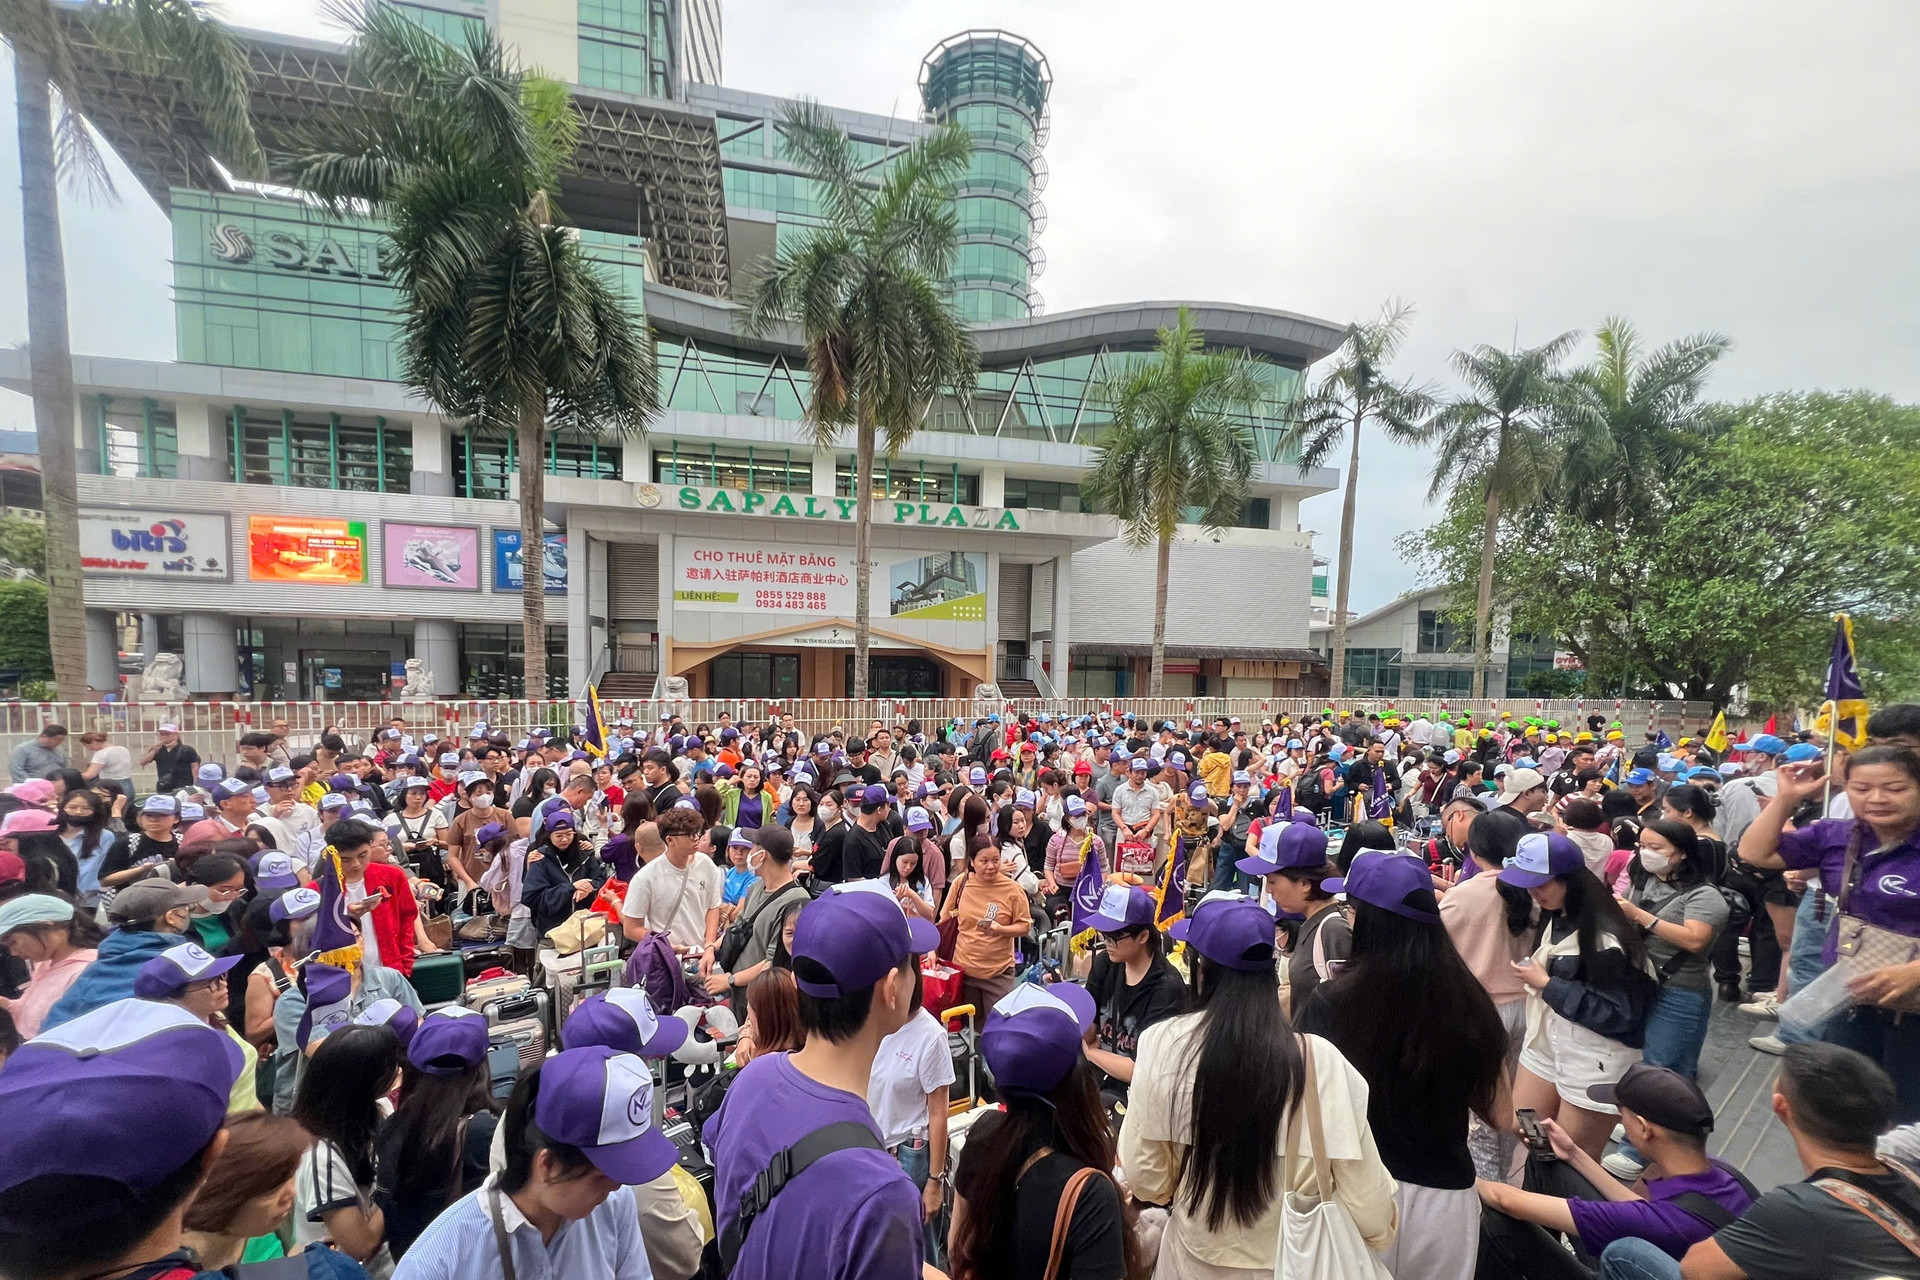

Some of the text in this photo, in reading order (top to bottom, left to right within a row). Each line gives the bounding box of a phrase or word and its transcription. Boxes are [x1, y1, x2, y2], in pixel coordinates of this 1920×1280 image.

[679, 487, 1020, 530] SAPALY PLAZA
[694, 550, 723, 563] CHO
[727, 551, 763, 564] THUÊ
[767, 552, 795, 568] MẶT
[686, 567, 849, 587] 邀请入驻萨帕利酒店商业中心
[681, 590, 702, 600] LIÊN
[756, 590, 826, 601] 0855 529 888
[756, 600, 827, 610] 0934 483 465
